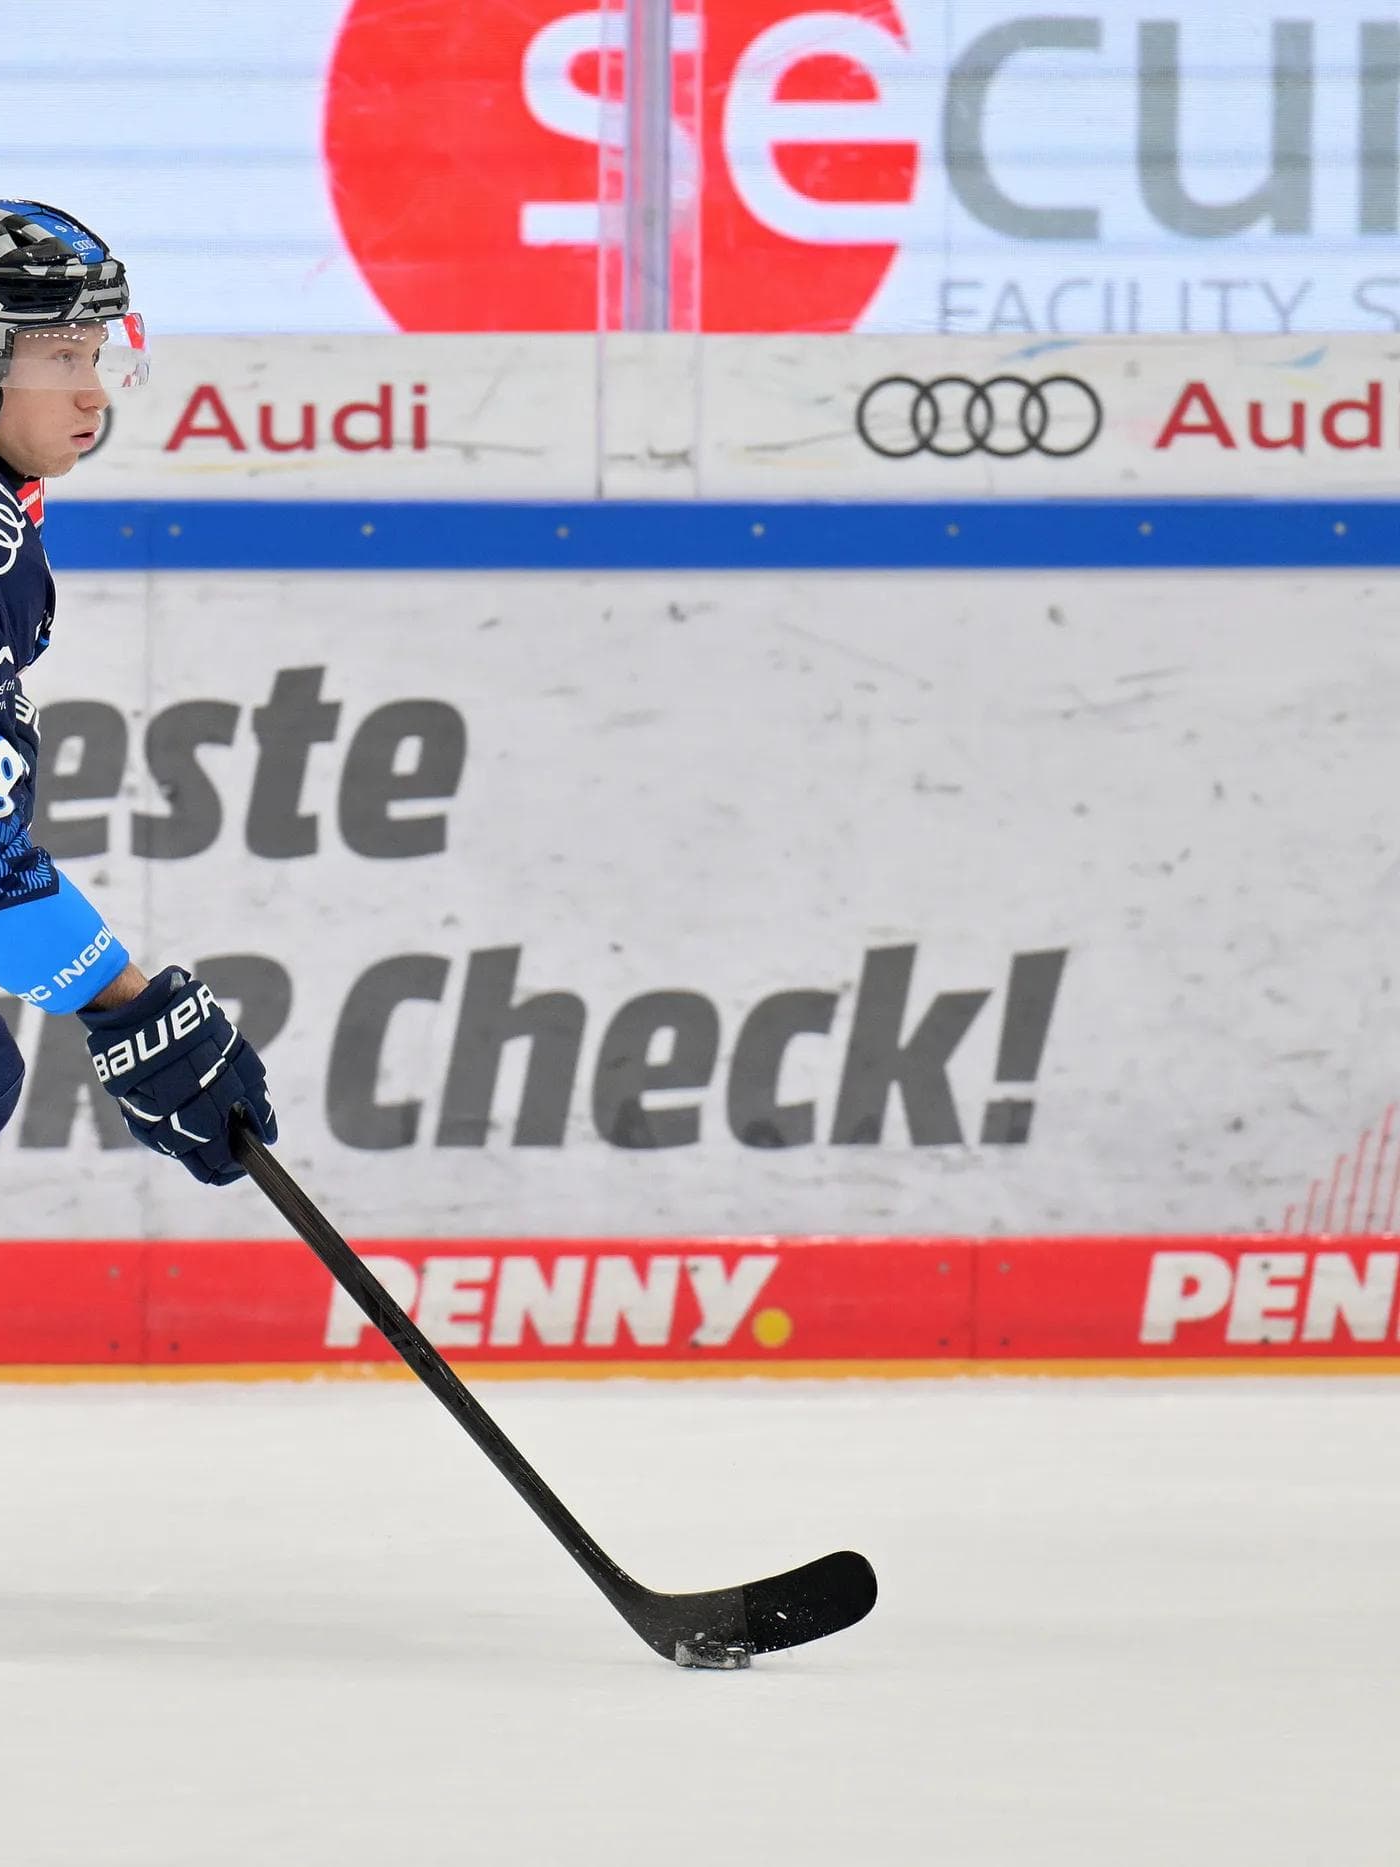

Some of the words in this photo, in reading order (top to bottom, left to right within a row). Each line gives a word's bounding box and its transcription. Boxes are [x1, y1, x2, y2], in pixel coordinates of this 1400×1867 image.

[164, 383, 429, 453] Audi
[1152, 380, 1400, 450] Aud
[36, 664, 468, 860] este
[324, 942, 1067, 1151] Check!
[1139, 1251, 1400, 1345] PEN
